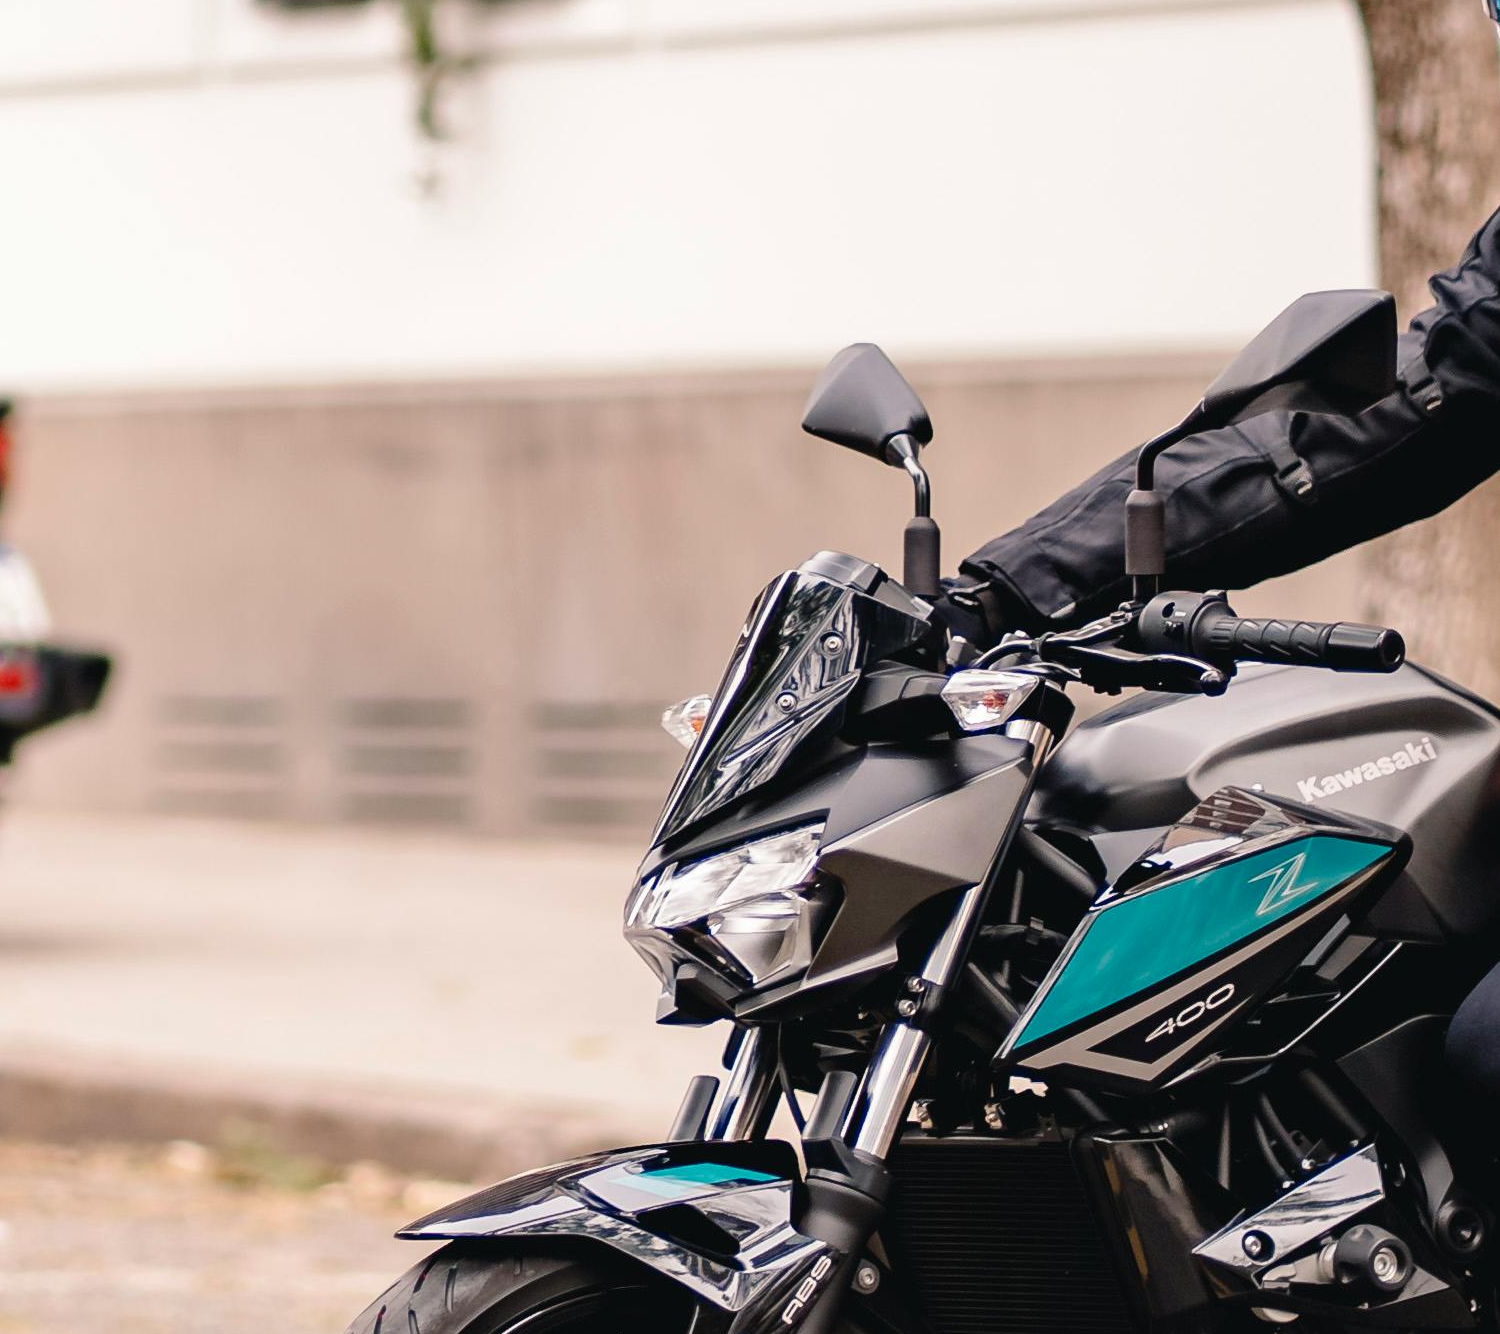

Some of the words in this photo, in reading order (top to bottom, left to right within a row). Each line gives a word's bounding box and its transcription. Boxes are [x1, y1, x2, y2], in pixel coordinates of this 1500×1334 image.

[1297, 737, 1438, 802] Kawasaki
[1145, 983, 1236, 1043] 400
[781, 1255, 832, 1325] ABS
